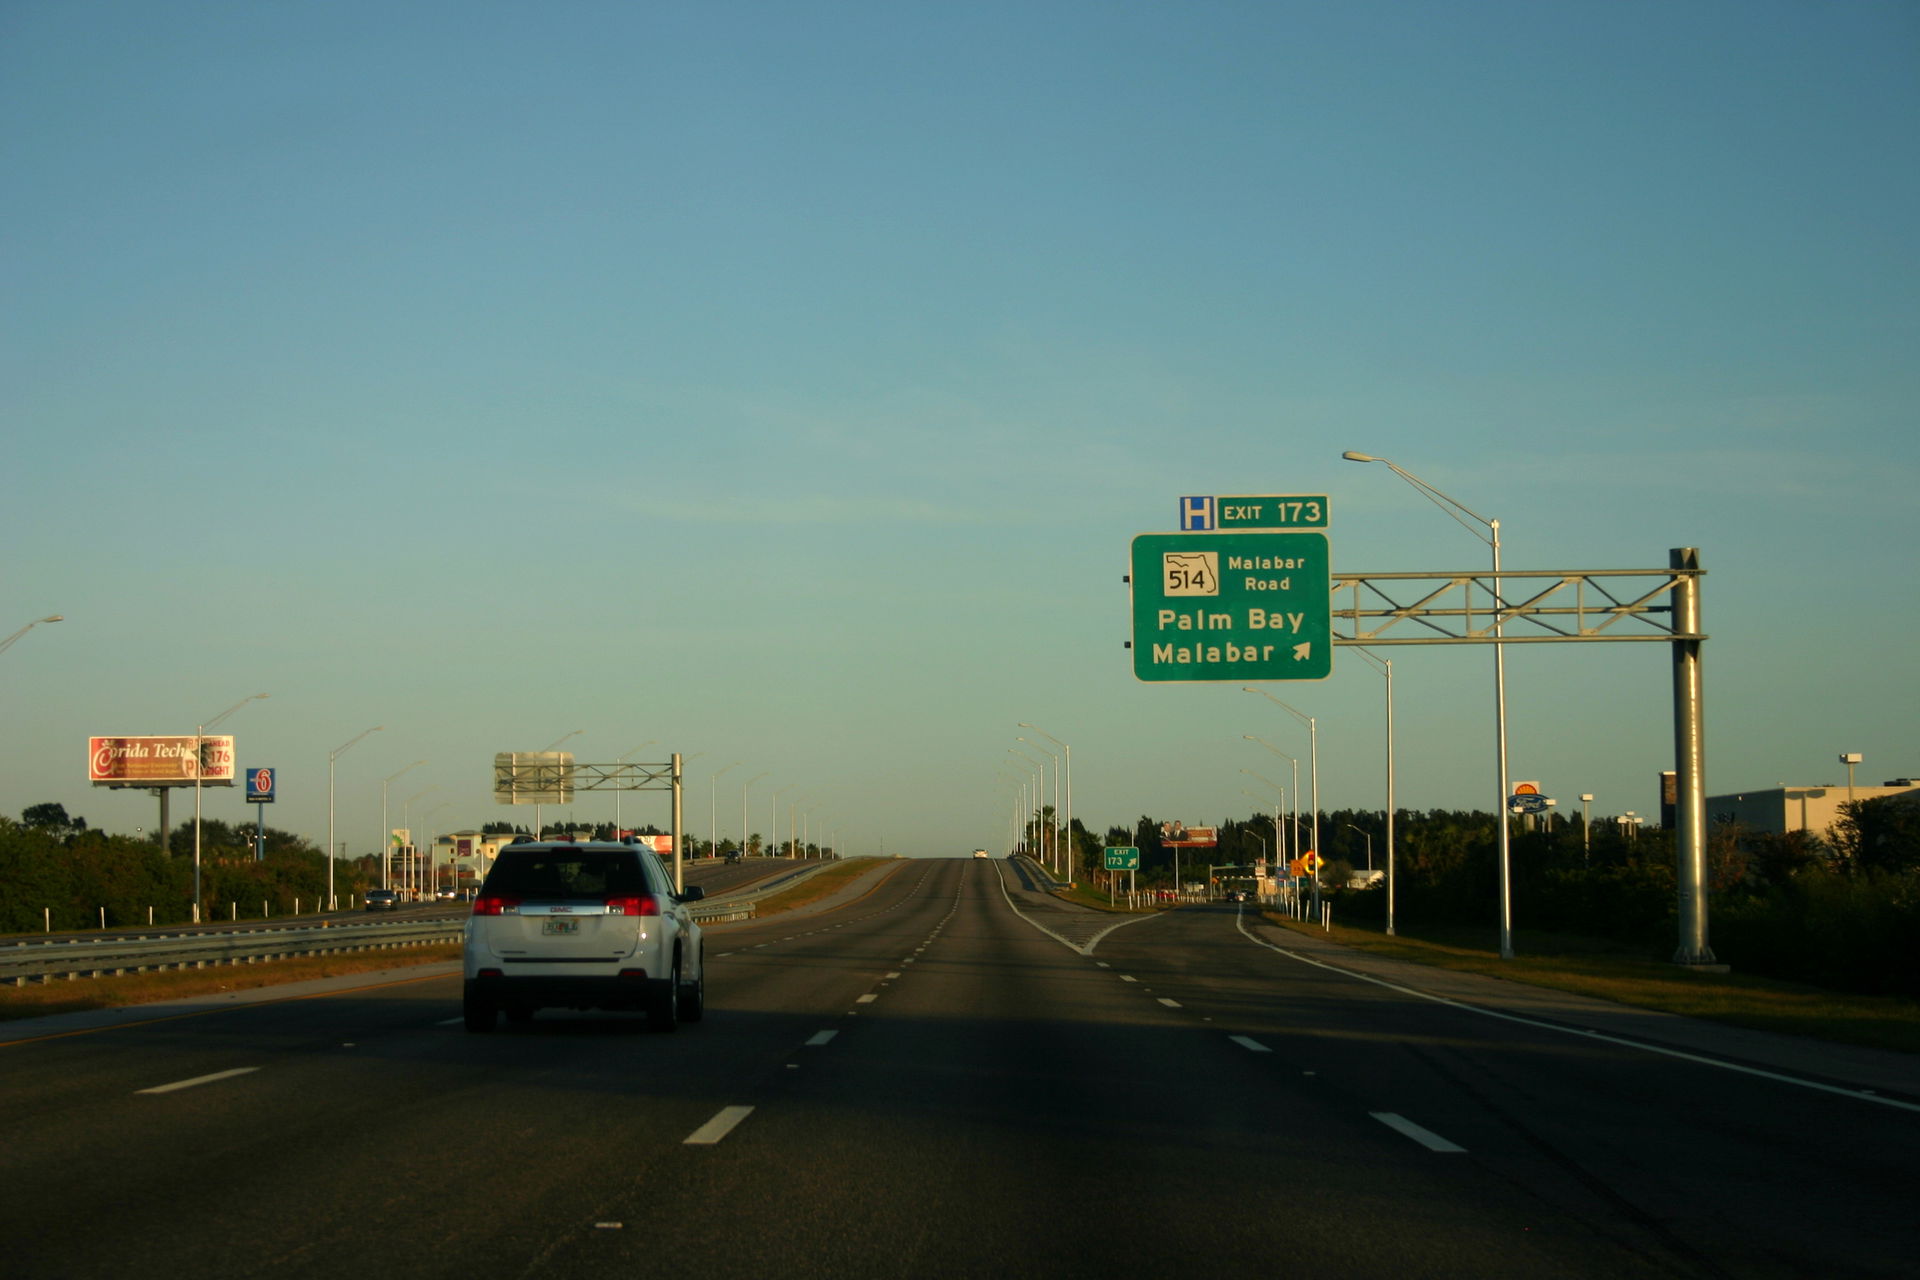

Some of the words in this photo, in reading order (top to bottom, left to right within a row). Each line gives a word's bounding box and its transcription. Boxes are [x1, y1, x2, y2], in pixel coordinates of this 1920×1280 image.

[1185, 498, 1211, 529] H
[1224, 506, 1262, 520] EXIT
[1278, 502, 1321, 522] 173
[1228, 556, 1305, 570] Malabar
[1168, 570, 1205, 589] 514
[1245, 577, 1290, 591] Road
[1157, 609, 1232, 631] Palm
[1248, 608, 1304, 634] Bay
[1152, 642, 1275, 664] Malabar
[211, 750, 230, 763] 176
[256, 768, 272, 793] 6
[1108, 857, 1122, 865] 173
